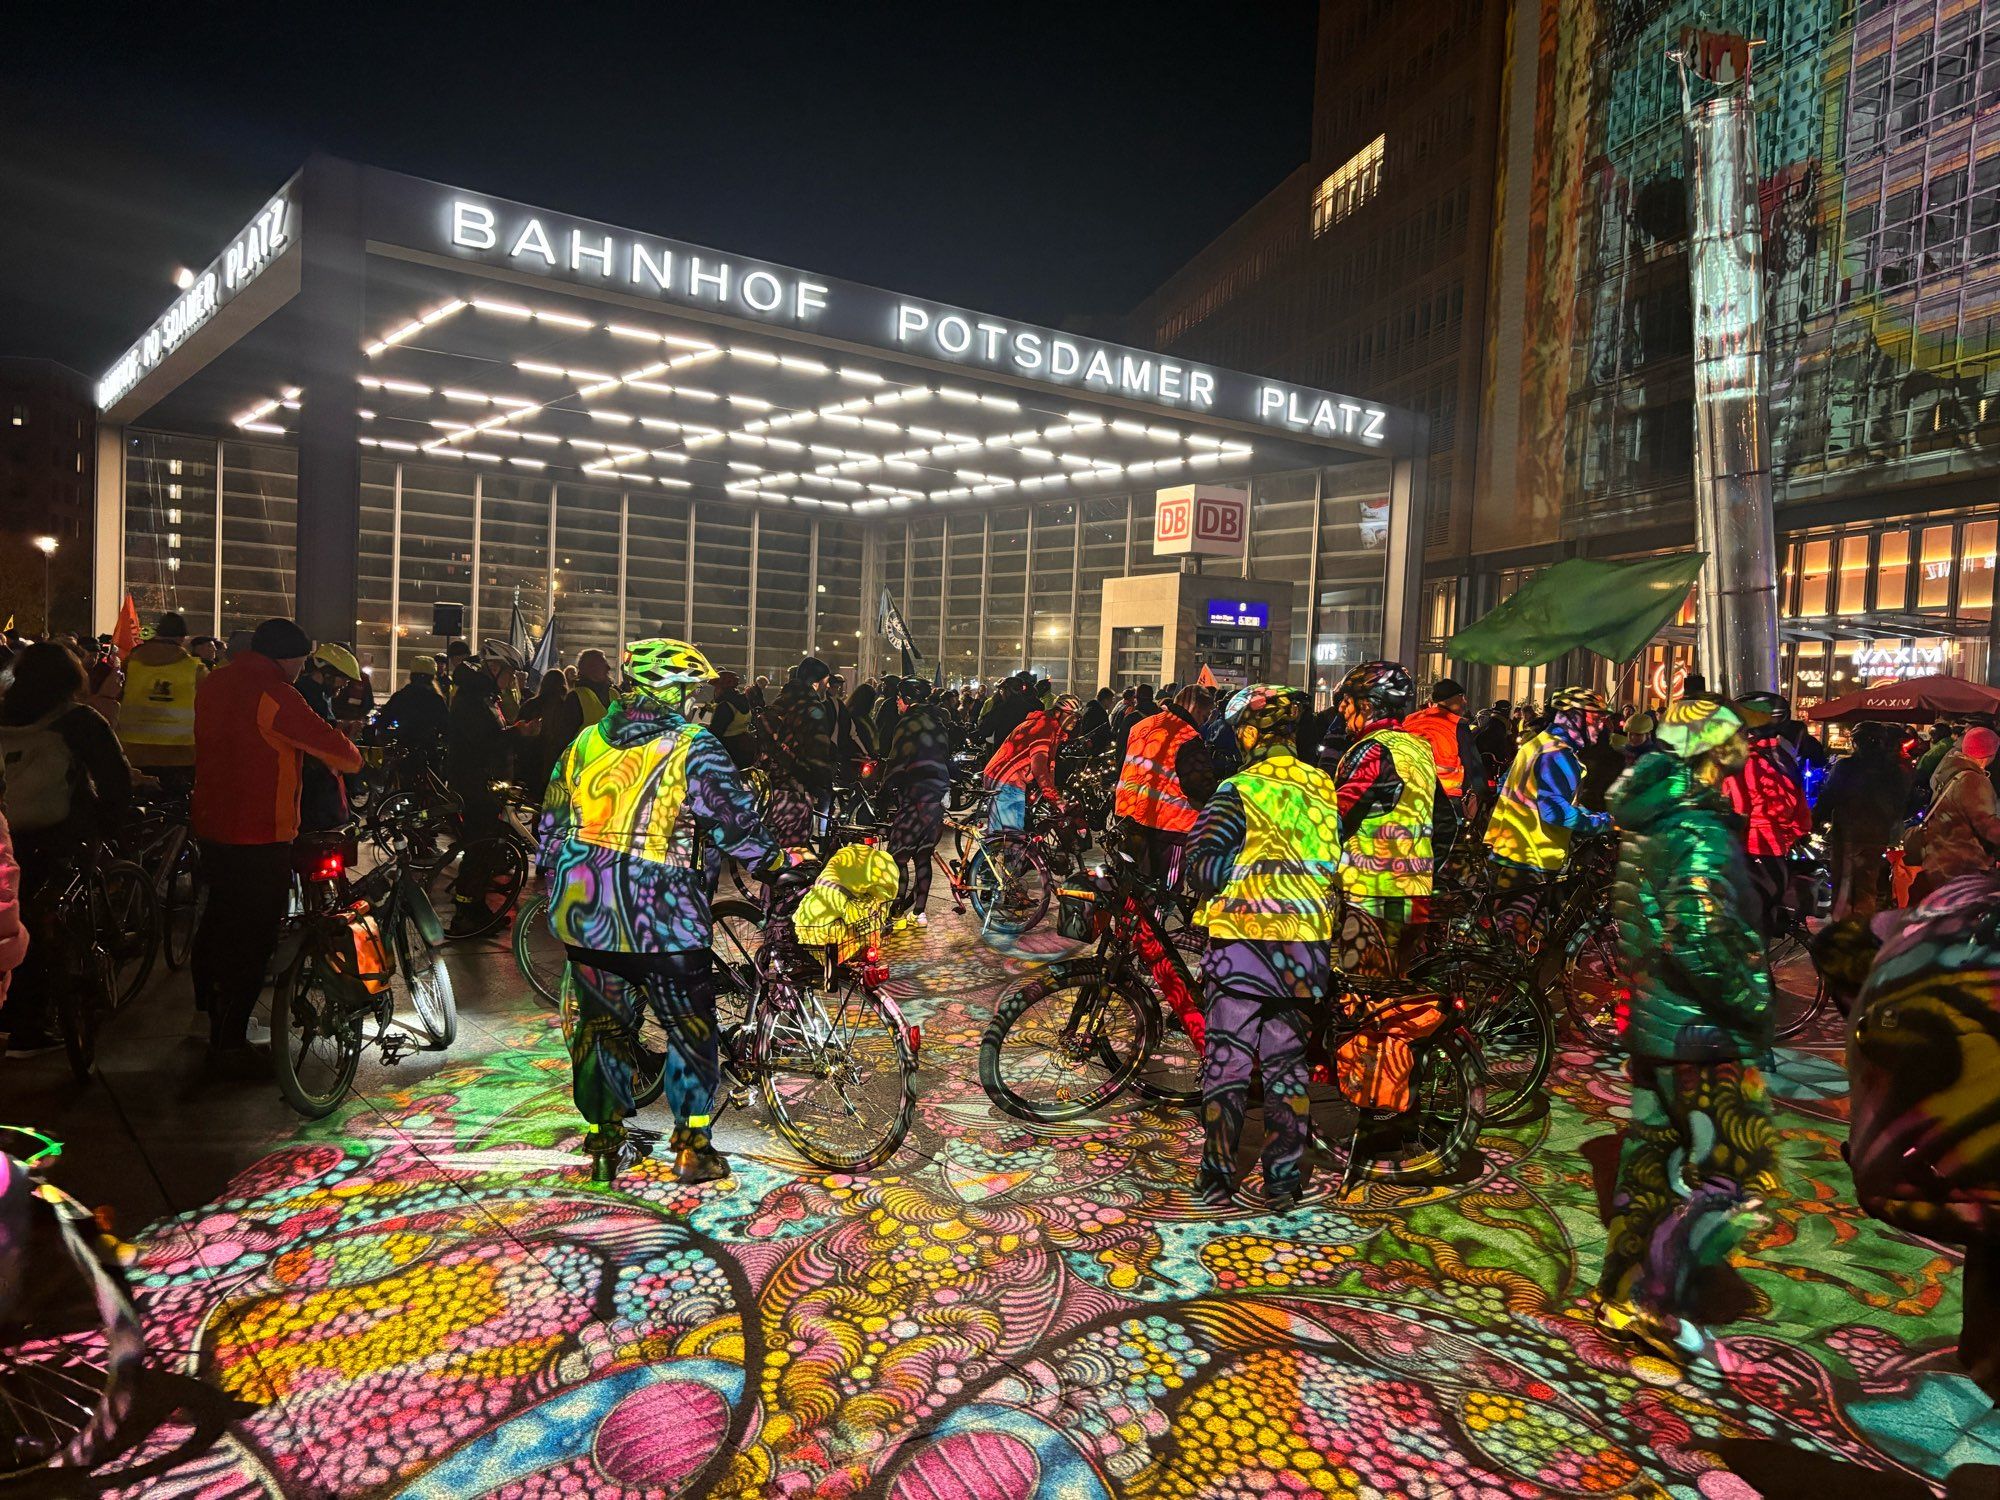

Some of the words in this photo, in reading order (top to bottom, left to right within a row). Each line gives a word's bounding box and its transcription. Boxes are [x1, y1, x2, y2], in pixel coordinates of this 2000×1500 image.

[227, 199, 286, 289] PLATZ
[452, 200, 830, 319] BAHNHOF
[897, 304, 1215, 405] POTSDAMER
[1260, 387, 1386, 440] PLATZ
[1161, 507, 1186, 534] DB
[1201, 505, 1238, 535] DB
[1852, 647, 1942, 664] MAXIM
[1867, 698, 1911, 707] MAXIM
